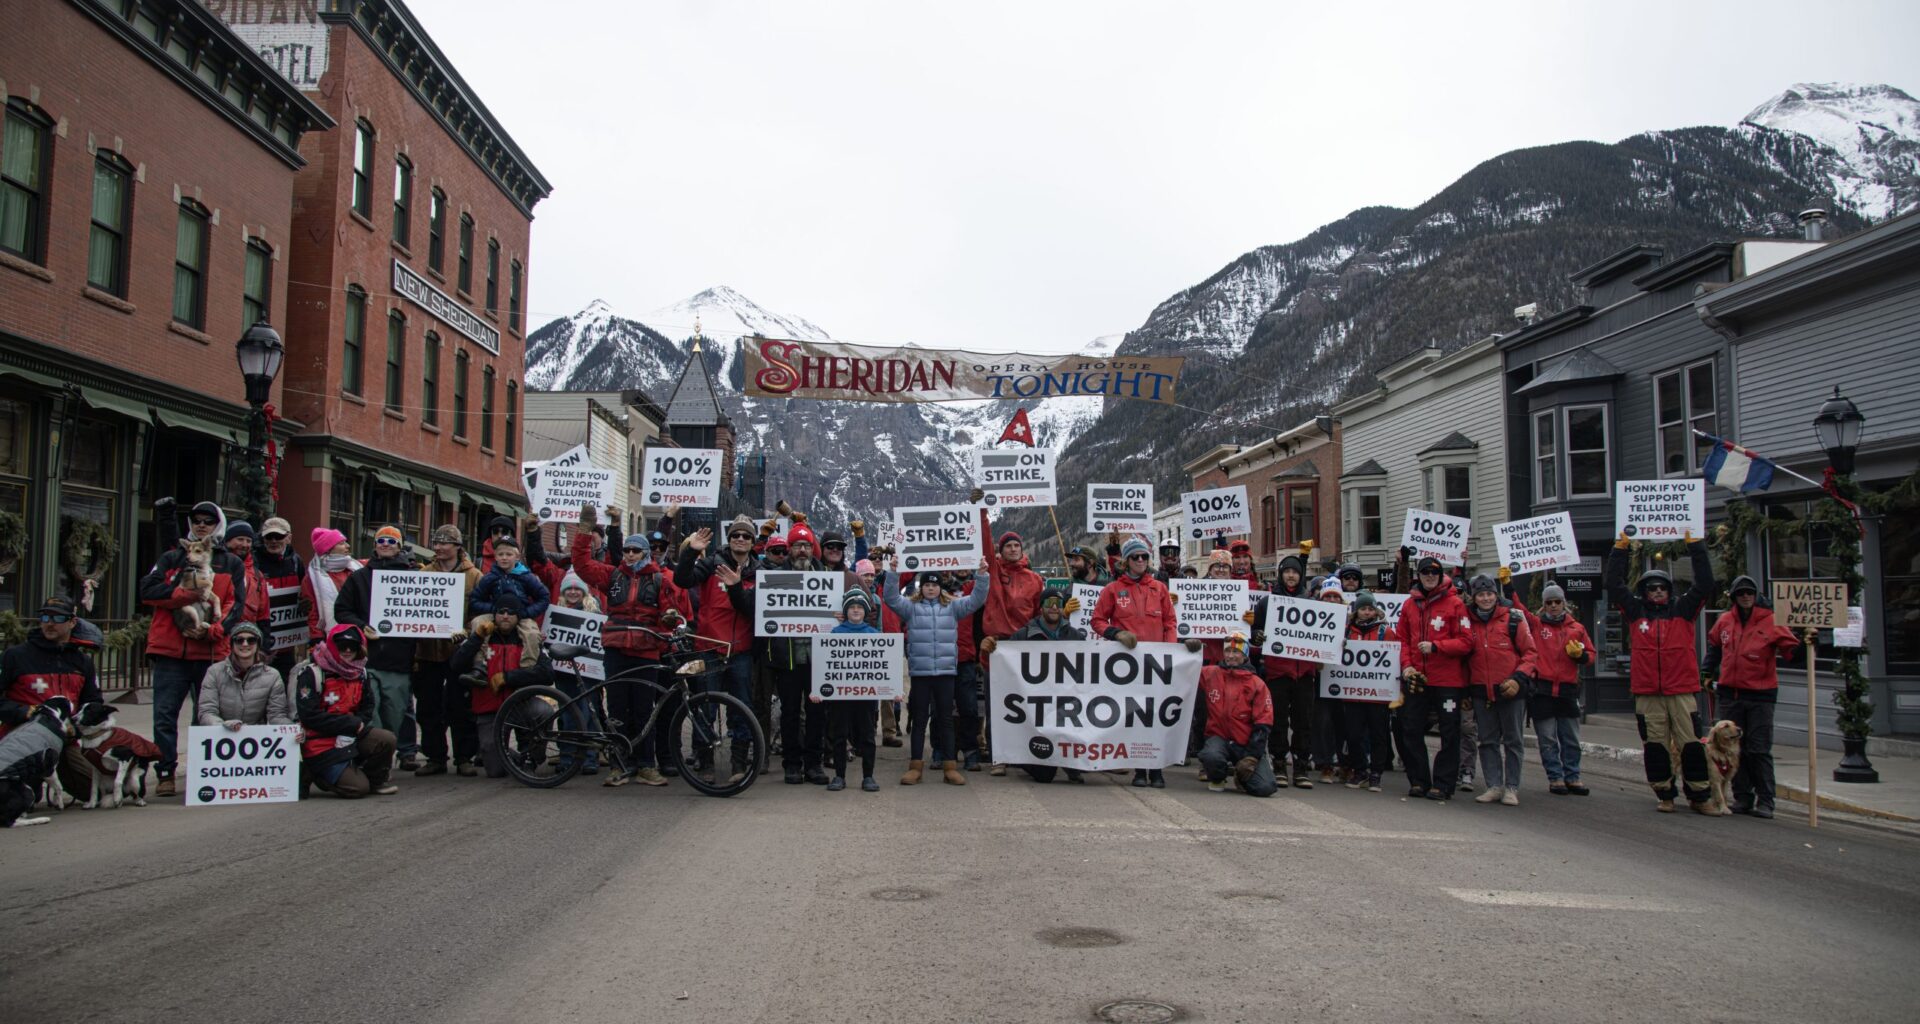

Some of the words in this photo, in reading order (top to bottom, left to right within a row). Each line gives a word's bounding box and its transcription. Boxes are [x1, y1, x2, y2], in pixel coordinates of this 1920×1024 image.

[396, 266, 428, 303] NEW
[431, 292, 496, 349] SHERIDAN
[755, 340, 957, 396] SHERIDAN
[973, 362, 1049, 372] OPERA
[1077, 362, 1151, 370] HOUSE
[986, 372, 1173, 400] TONIGHT
[654, 457, 711, 474] 100%
[1021, 454, 1045, 465] ON
[545, 470, 574, 478] HONK
[985, 469, 1044, 481] STRIKE,
[553, 480, 599, 488] SUPPORT
[652, 479, 710, 487] SOLIDARITY
[548, 489, 601, 498] TELLURIDE
[663, 495, 696, 503] TPSPA
[999, 495, 1034, 503] TPSPA
[1126, 489, 1145, 498] ON
[1096, 501, 1144, 512] STRIKE,
[1190, 494, 1240, 513] 100%
[554, 510, 580, 518] TPSP
[944, 511, 971, 524] ON
[1192, 512, 1241, 524] SOLIDARITY
[1414, 518, 1461, 538] 100%
[1501, 522, 1530, 534] HONK
[1541, 517, 1563, 526] YOU
[1639, 527, 1677, 535] TPSPA
[906, 528, 970, 542] STRIKE,
[1511, 527, 1556, 541] SUPPORT
[1411, 535, 1459, 549] SOLIDARITY
[1509, 535, 1562, 550] TELLURIDE
[1419, 550, 1446, 560] TPSPA
[1510, 551, 1525, 559] SKI
[1528, 544, 1565, 556] PATROL
[921, 557, 959, 567] TPSPA
[1522, 557, 1557, 569] TPSPA
[381, 576, 416, 584] HONK
[431, 578, 456, 586] YOU
[807, 578, 833, 590] ON
[391, 587, 446, 596] SUPPORT
[1777, 584, 1842, 600] LIVABLE
[386, 598, 449, 607] TELLURIDE
[767, 594, 832, 609] STRIKE,
[1790, 601, 1833, 614] WAGES
[270, 608, 302, 622] STRIK
[384, 609, 402, 617] SKI
[406, 610, 450, 618] PATROL
[1277, 606, 1336, 630] 100%
[1787, 615, 1833, 625] PLEASE
[395, 623, 436, 633] TPSPA
[781, 624, 819, 633] TPSPA
[277, 634, 302, 645] TPSPA
[549, 628, 602, 651] STRIKE,
[1275, 628, 1335, 642] SOLIDARITY
[821, 639, 855, 647] HONK
[858, 639, 868, 647] IF
[870, 639, 894, 647] YOU
[831, 650, 885, 658] SUPPORT
[1286, 646, 1320, 658] TPSPA
[1341, 649, 1391, 668] 00%
[826, 661, 888, 669] TELLURIDE
[1021, 652, 1173, 685] UNION
[1330, 671, 1391, 680] SOLIDARITY
[837, 687, 876, 695] TPSPA
[1343, 687, 1377, 696] TPSPA
[1003, 693, 1184, 728] STRONG
[201, 737, 286, 760] 100%
[1058, 743, 1128, 760] TPSPA
[201, 766, 286, 778] SOLIDARITY
[219, 788, 268, 799] TPSPA
